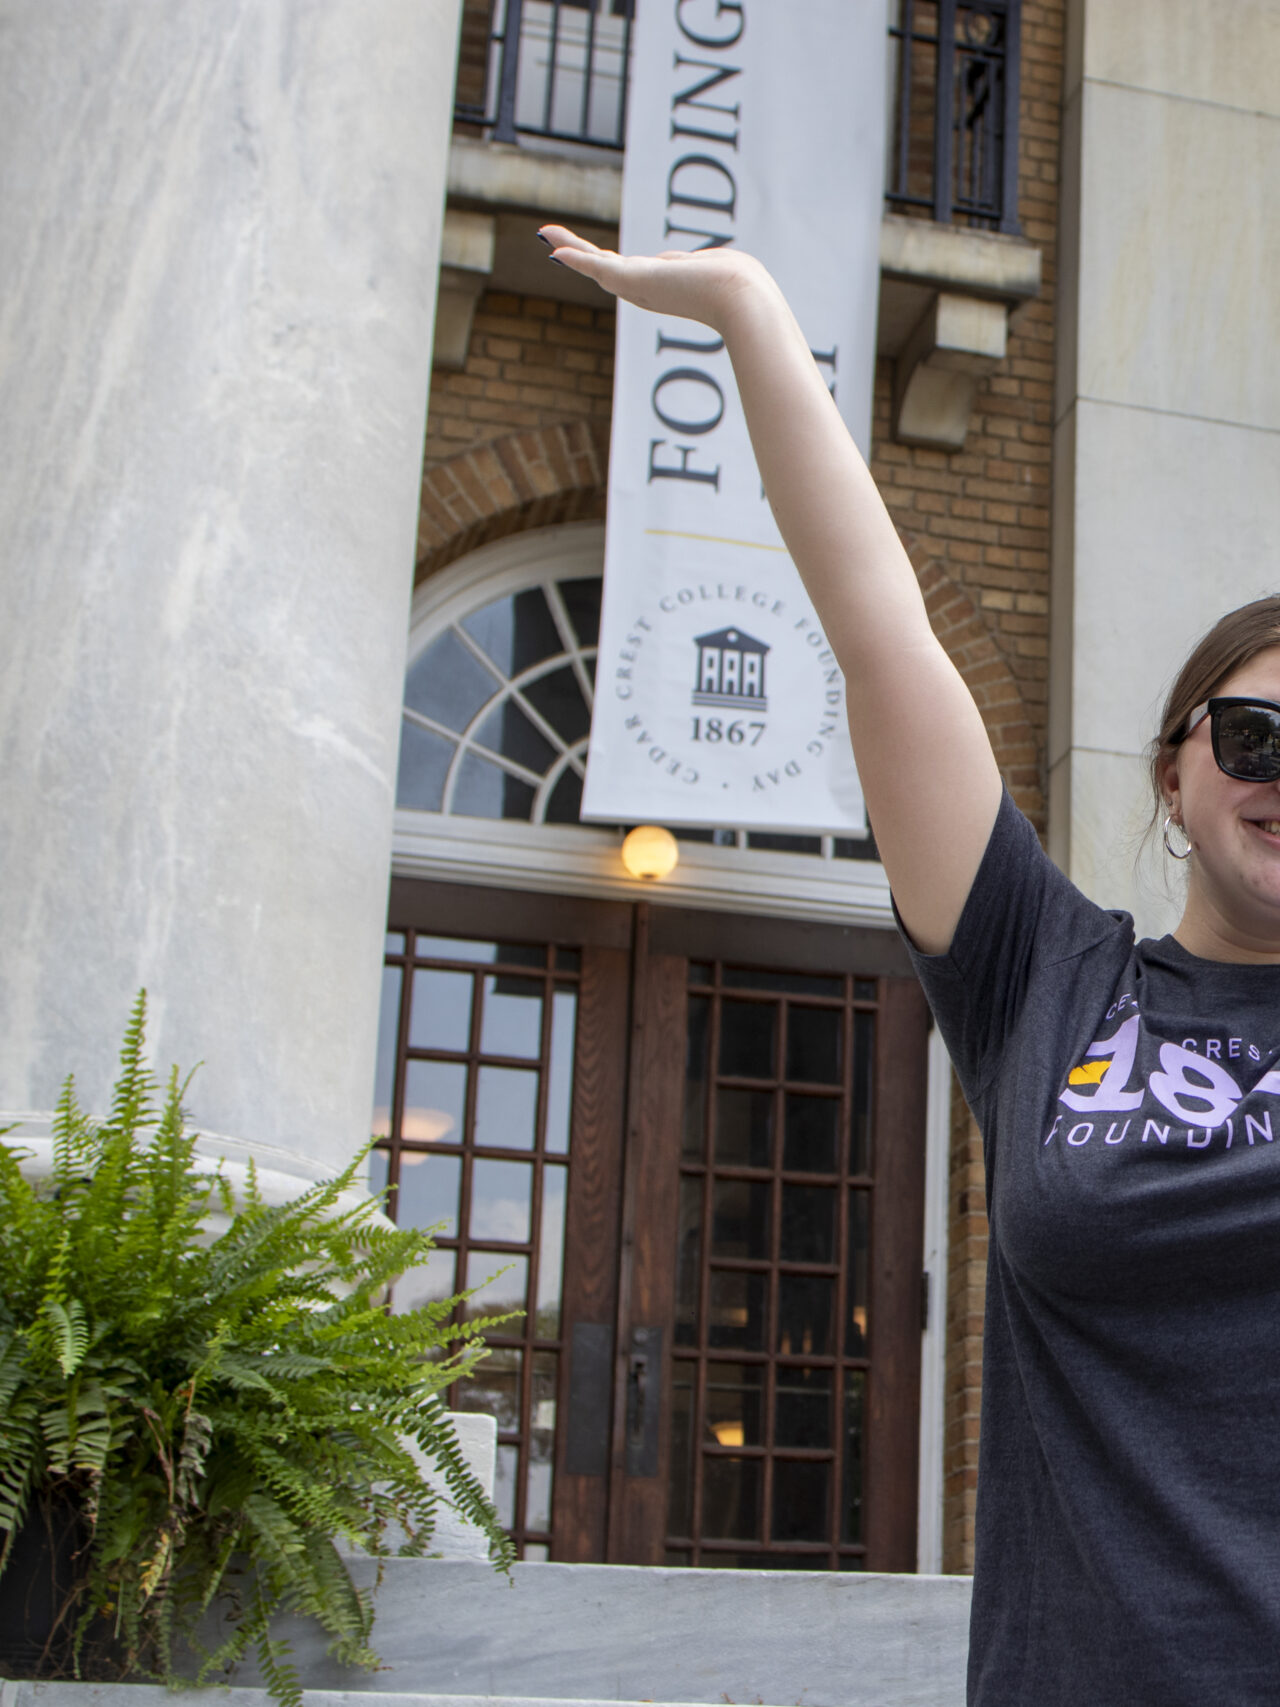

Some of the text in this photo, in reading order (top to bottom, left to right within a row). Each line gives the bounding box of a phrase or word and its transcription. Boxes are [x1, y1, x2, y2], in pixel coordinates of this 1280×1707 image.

[615, 583, 842, 792] CEDAR CREST COLLEGE FOUNDING DAY
[690, 716, 766, 747] 1867
[1182, 1038, 1272, 1061] CRES
